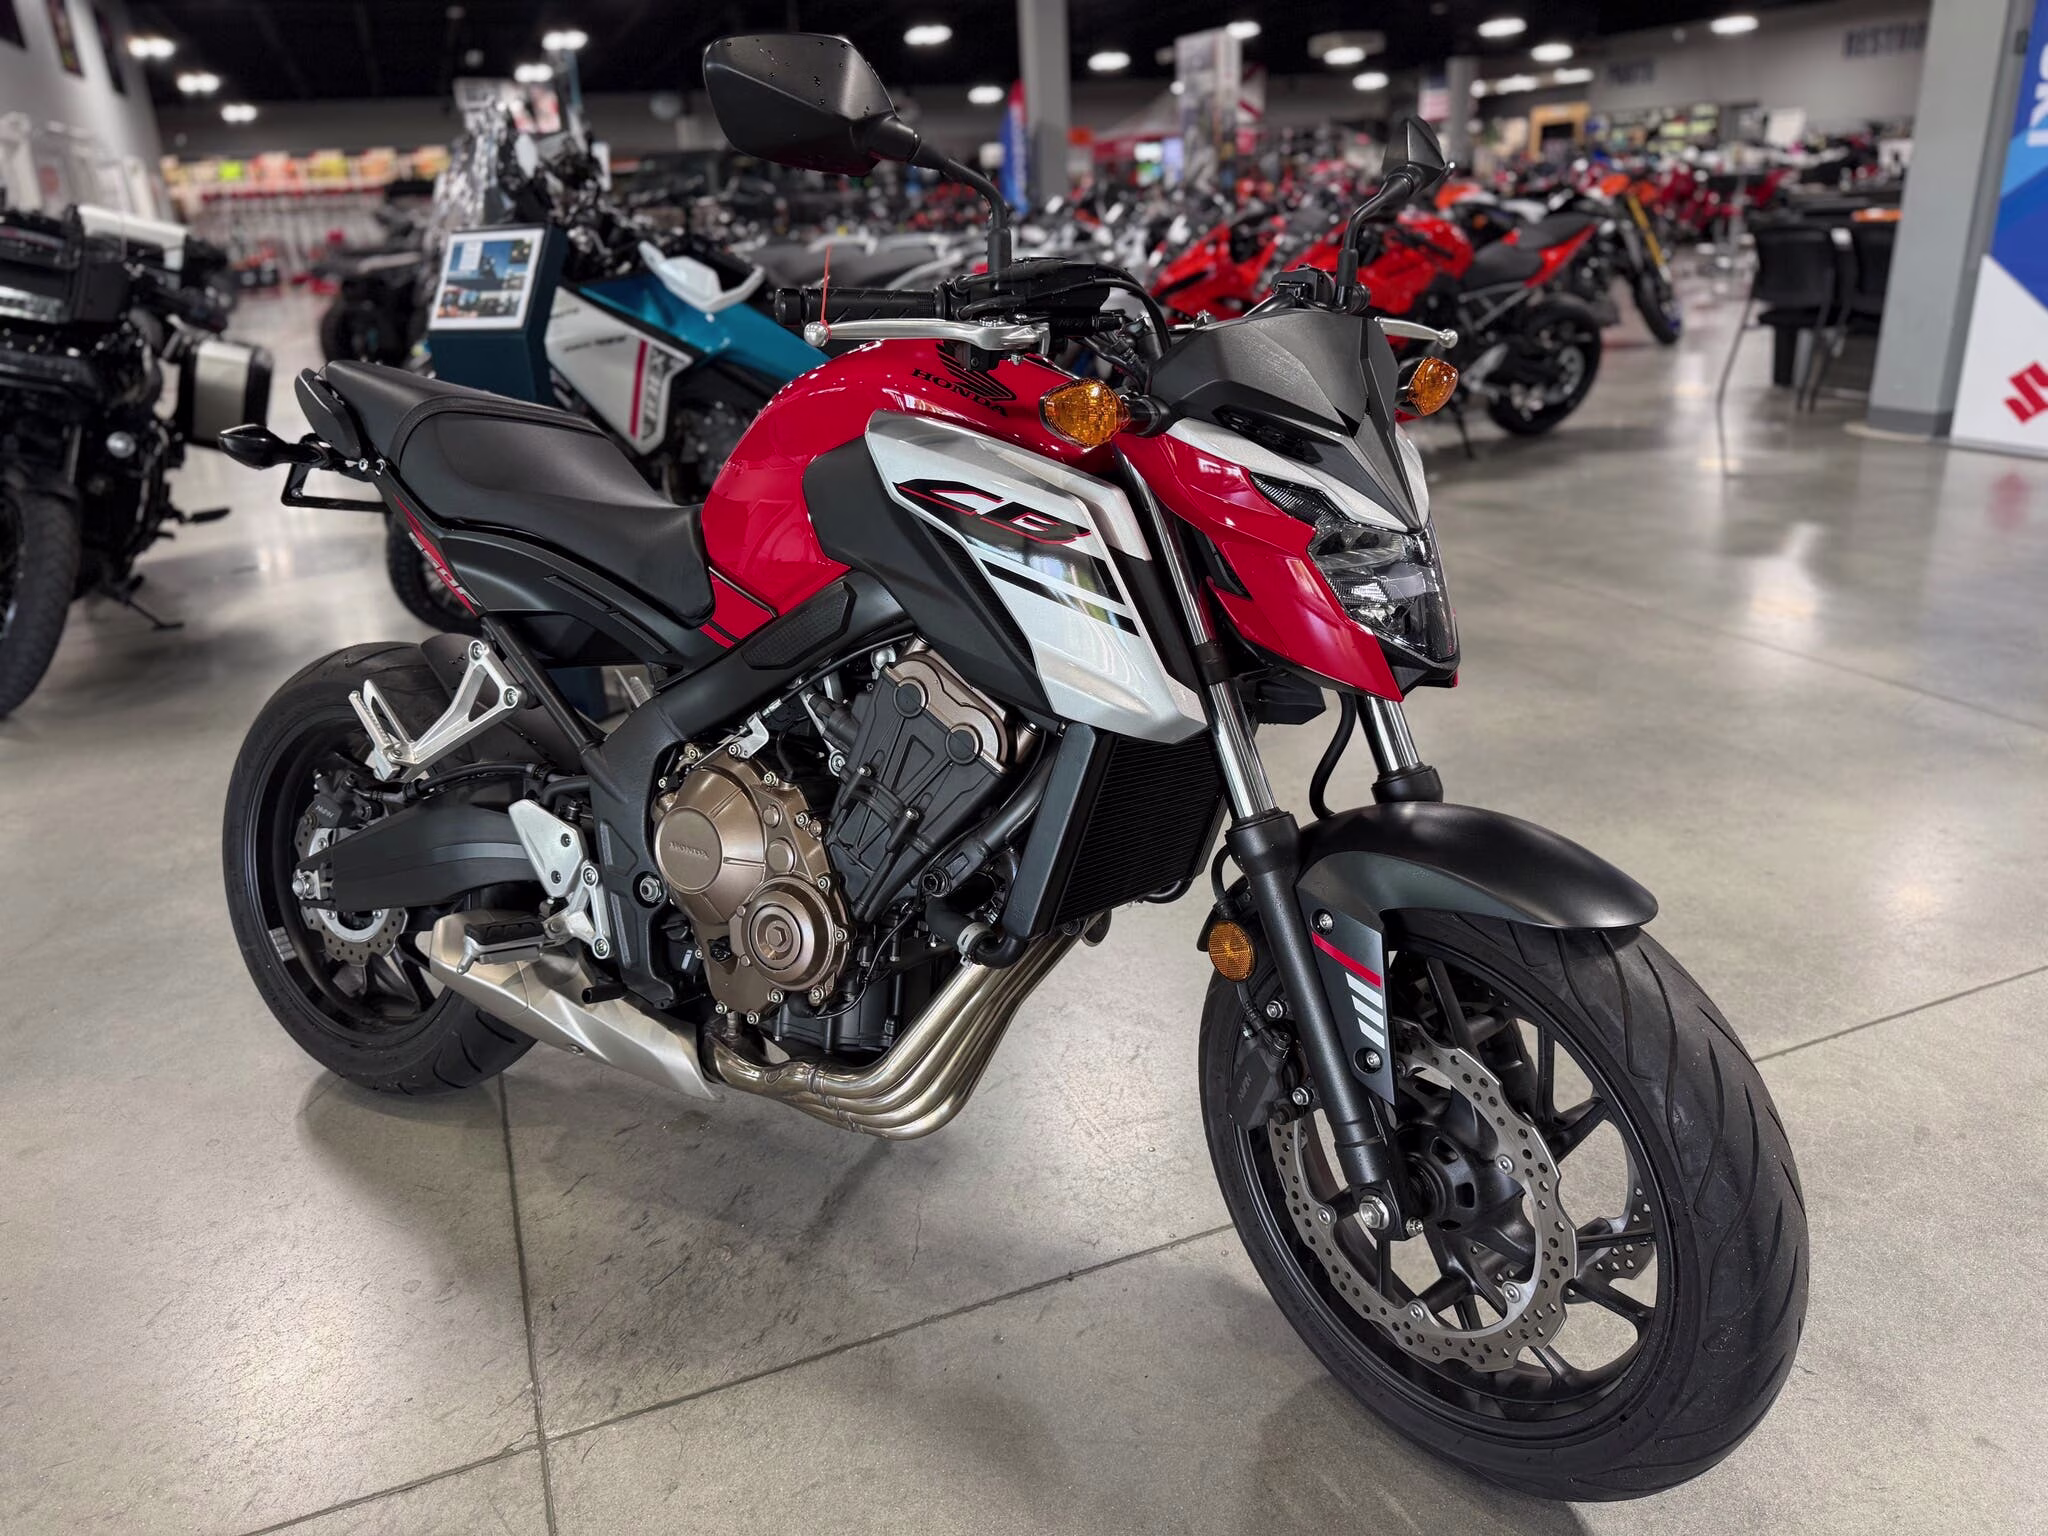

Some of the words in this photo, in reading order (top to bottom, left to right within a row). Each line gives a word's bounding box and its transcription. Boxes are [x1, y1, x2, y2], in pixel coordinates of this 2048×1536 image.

[912, 368, 1008, 417] HONDA
[893, 479, 1091, 545] CB
[668, 840, 710, 860] HONDA
